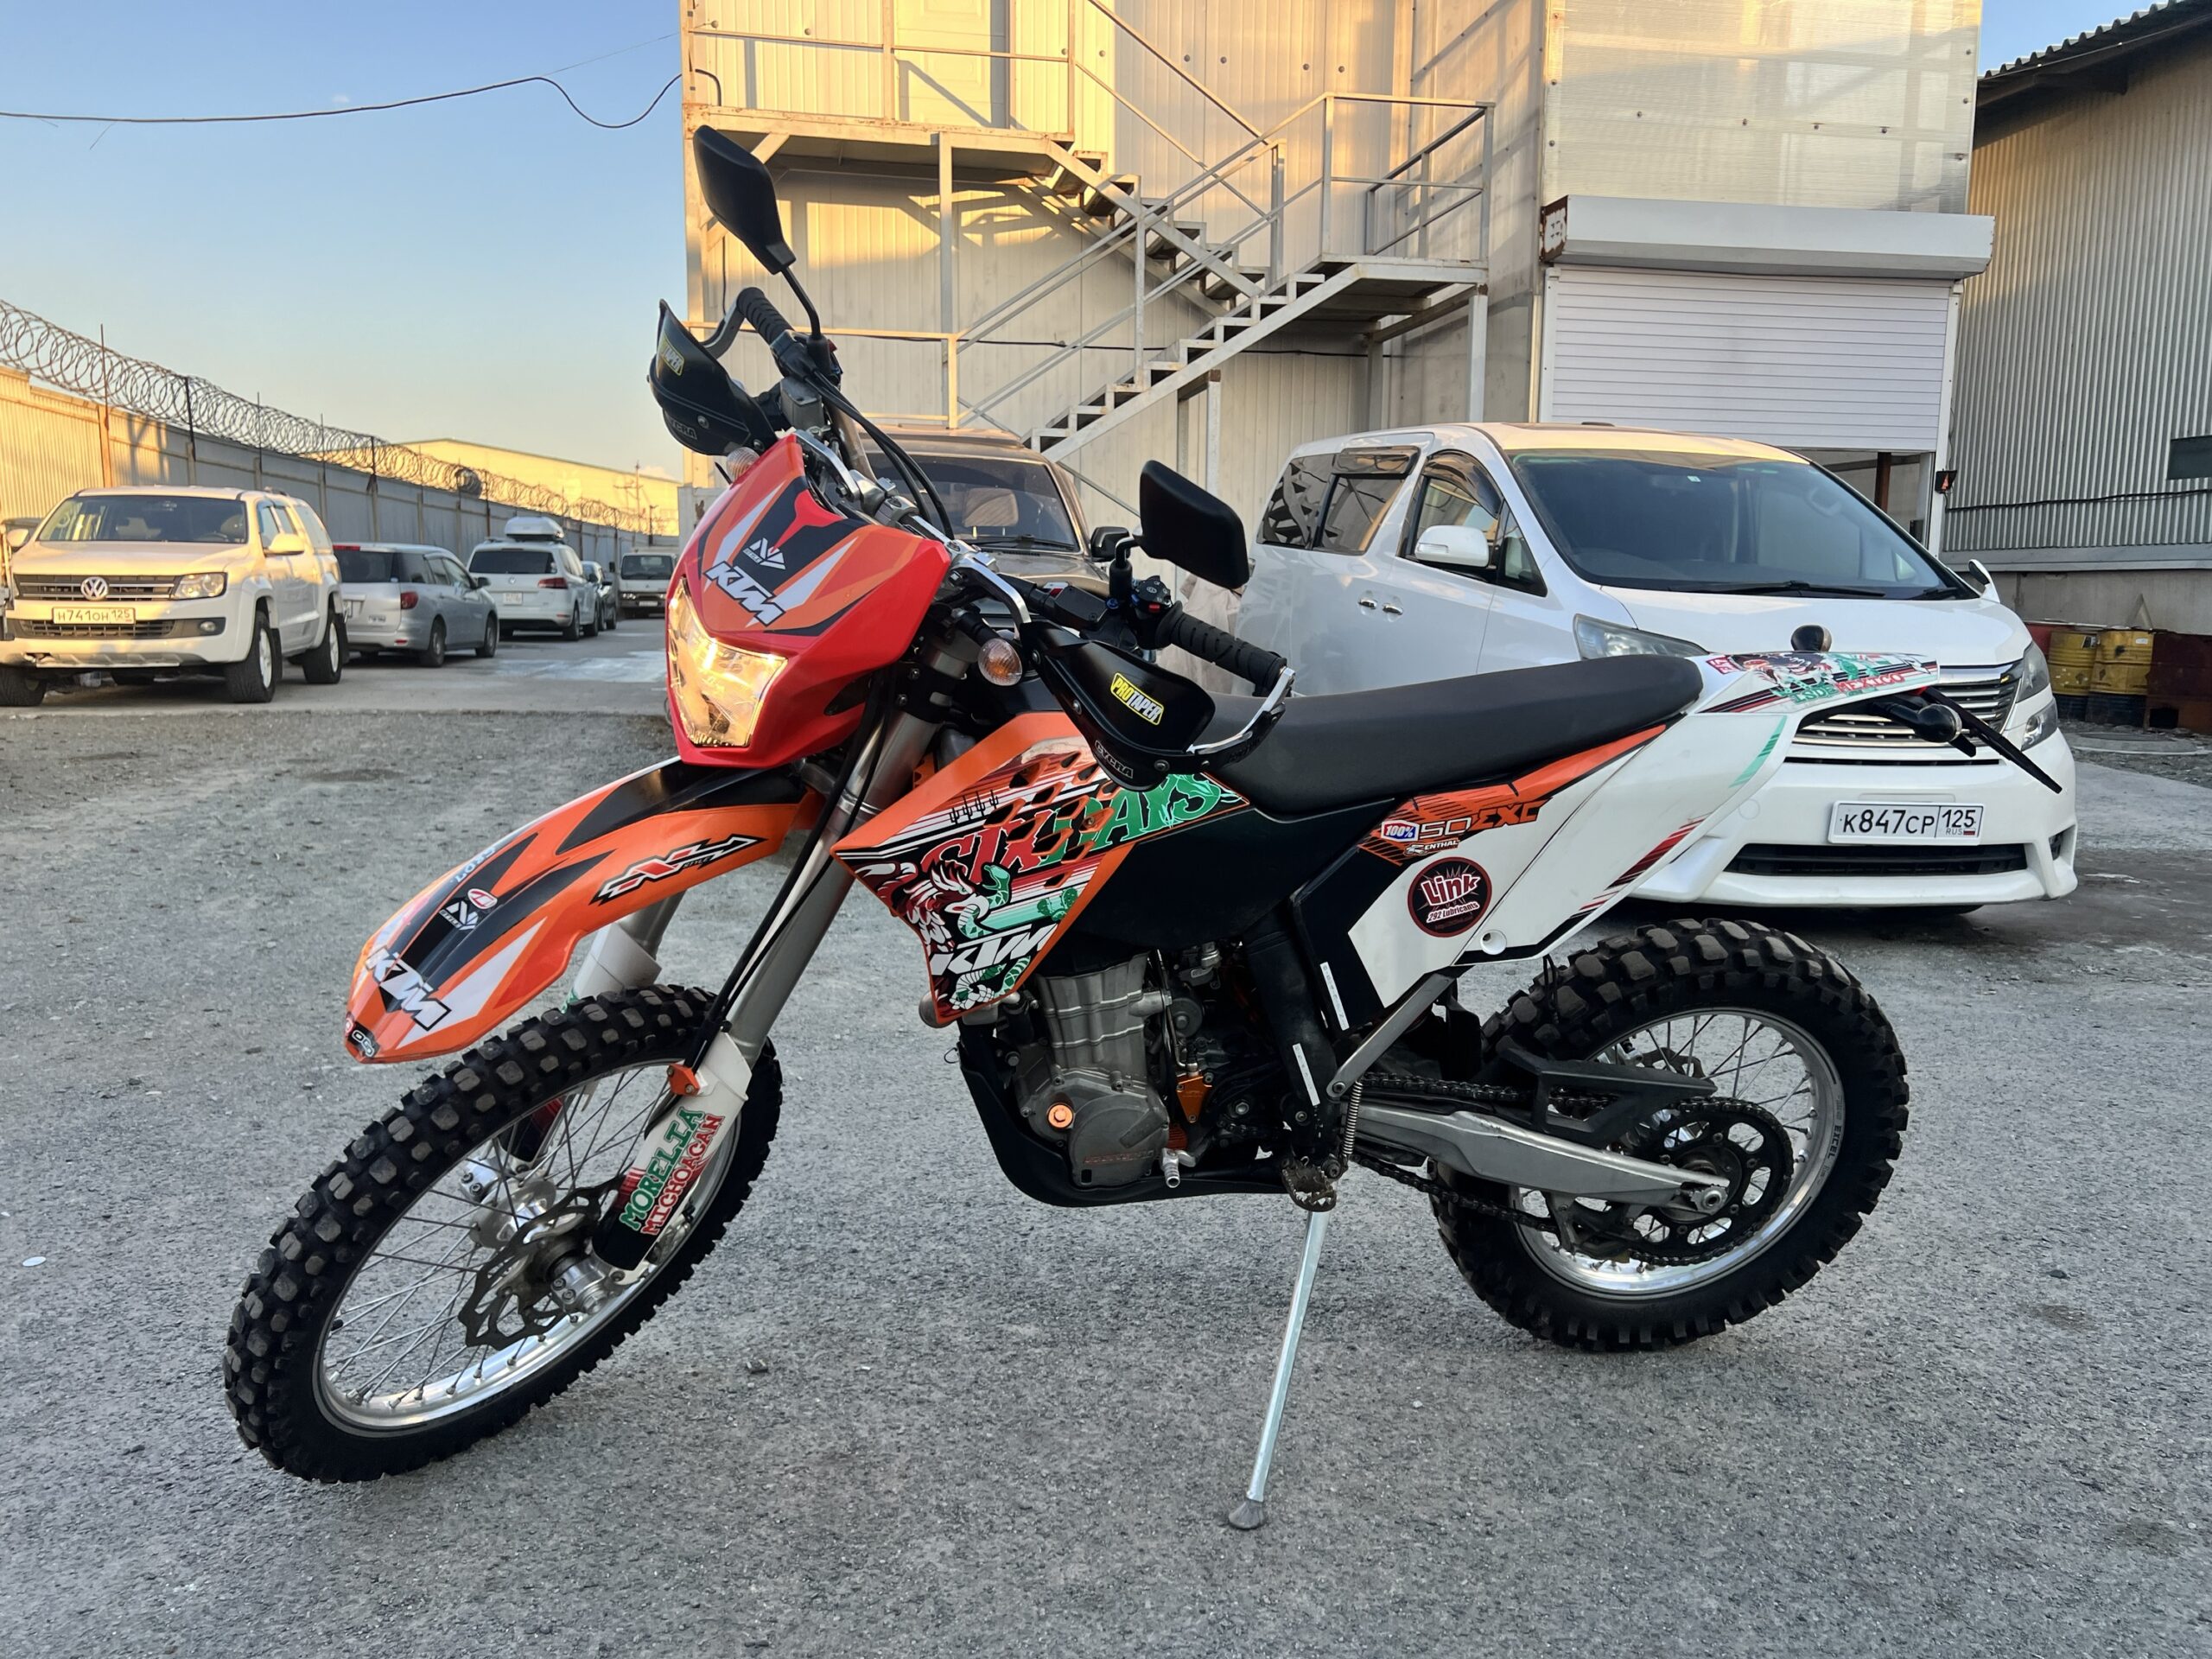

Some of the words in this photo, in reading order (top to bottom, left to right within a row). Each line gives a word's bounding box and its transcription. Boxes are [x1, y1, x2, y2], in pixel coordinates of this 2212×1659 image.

[703, 561, 785, 626] KTM
[111, 609, 131, 619] 125
[1112, 677, 1162, 722] PROTAPER
[1835, 673, 1905, 694] MEXICO
[1094, 740, 1134, 779] CYCRA
[1385, 824, 1414, 838] 100%
[1469, 798, 1551, 831] EXC
[1843, 809, 1935, 834] К847СР
[1942, 809, 1976, 828] 125
[1421, 874, 1481, 906] Link
[1427, 912, 1443, 923] 292
[1442, 901, 1480, 918] Lubricants
[930, 923, 1058, 976] KTM
[365, 946, 451, 1032] KTM
[1827, 1125, 1842, 1159] EXCEL
[619, 1106, 709, 1231] MORELIA
[640, 1113, 725, 1235] MICHOACAN
